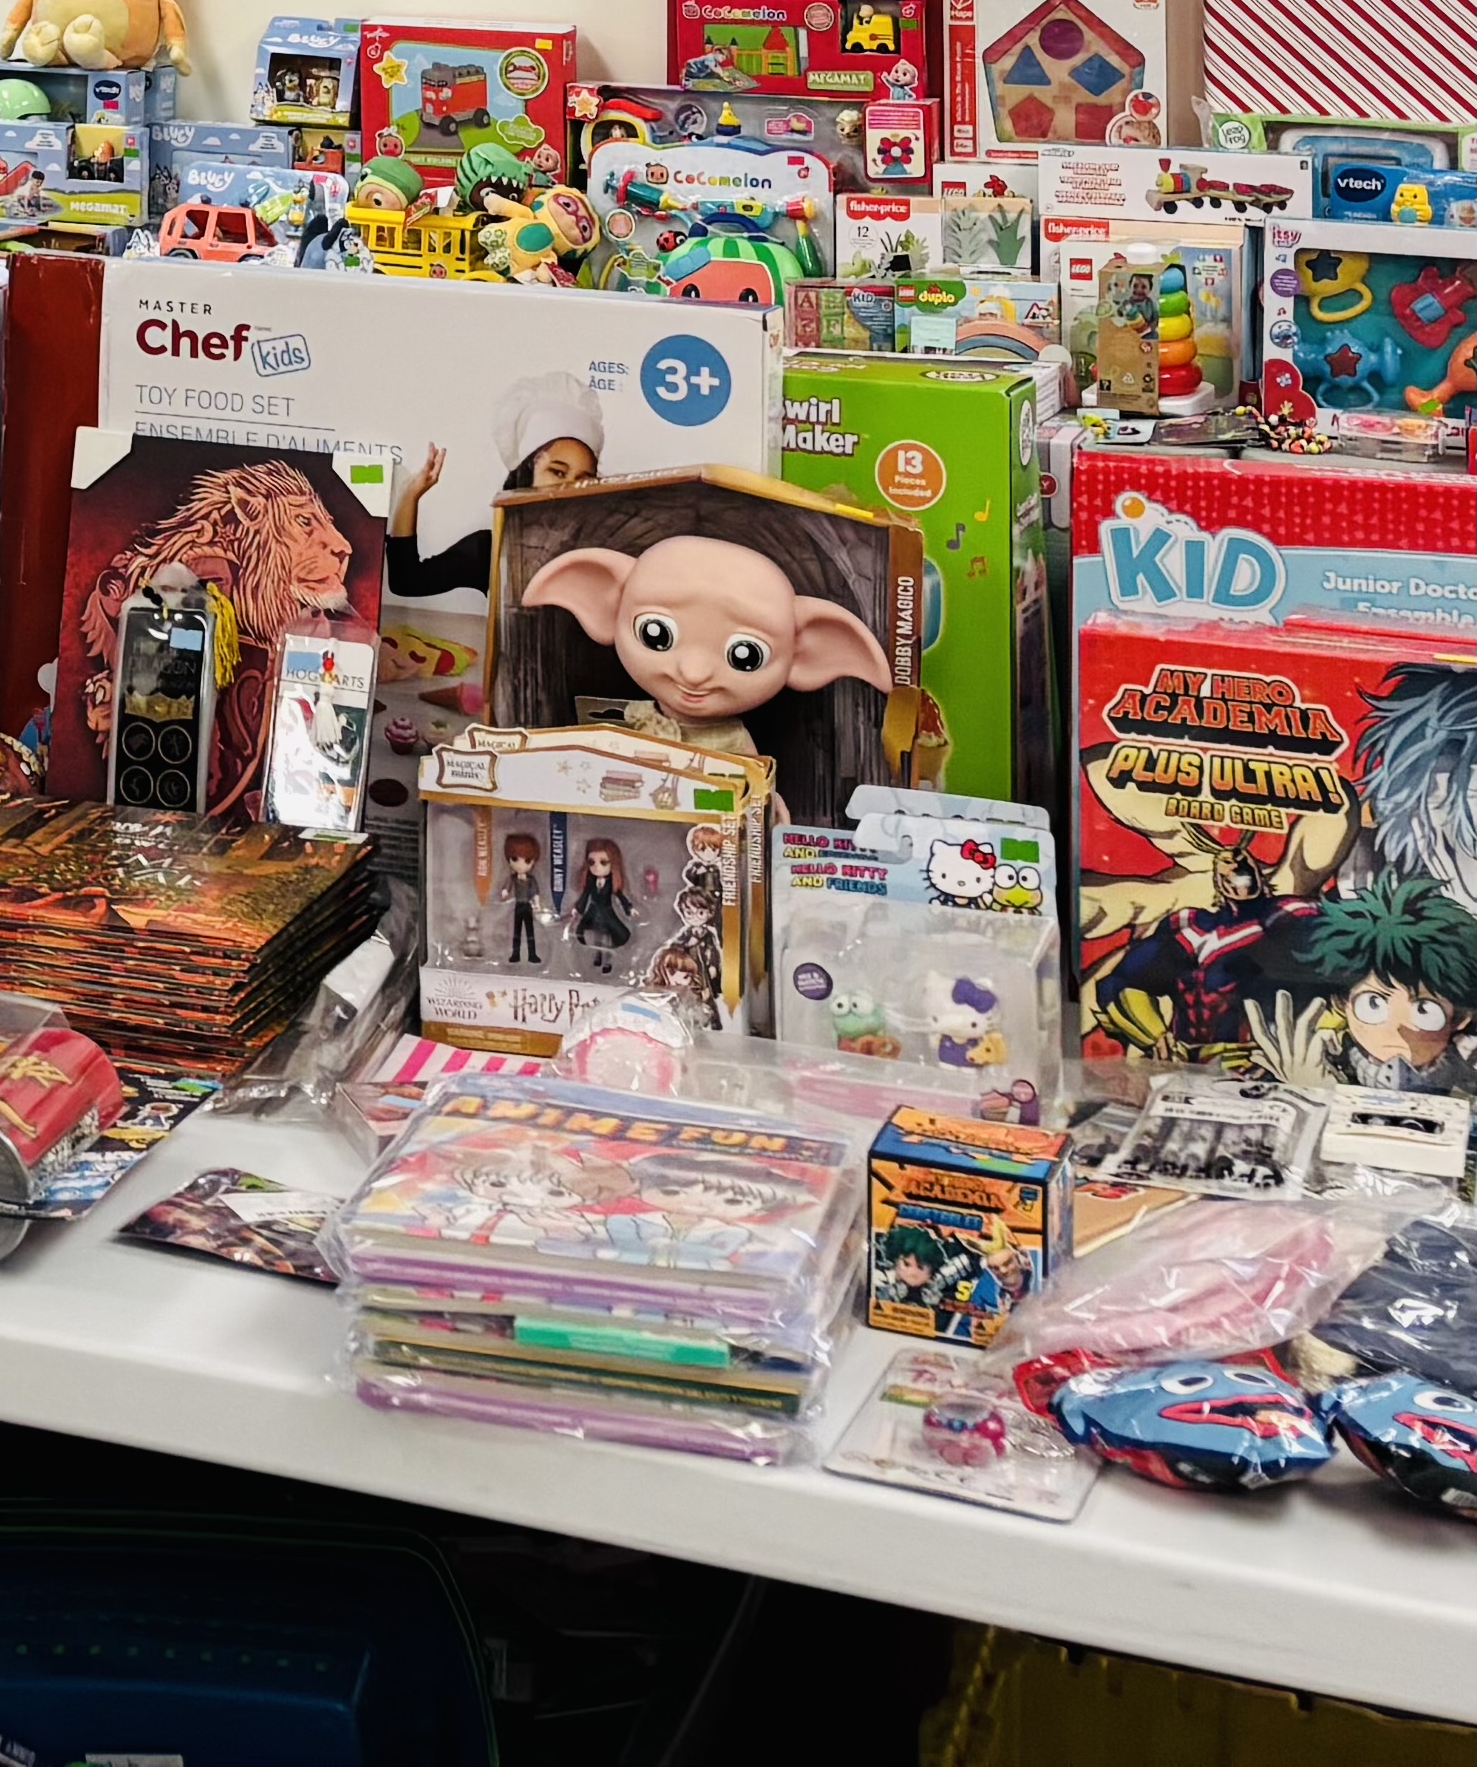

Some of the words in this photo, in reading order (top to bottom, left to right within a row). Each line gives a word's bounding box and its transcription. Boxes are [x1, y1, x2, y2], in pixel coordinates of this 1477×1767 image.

[808, 71, 868, 85] MEGAMAT
[1336, 177, 1382, 192] vtech
[849, 200, 908, 216] fisher-price
[857, 225, 870, 239] 12
[138, 298, 213, 316] MASTER
[918, 290, 955, 306] duplo
[136, 318, 252, 362] Chef
[257, 339, 306, 371] kids
[587, 359, 629, 376] AGES:
[654, 357, 721, 402] 3+
[135, 384, 178, 407] TOY
[184, 388, 244, 413] FOOD
[251, 394, 296, 418] SET
[897, 450, 924, 475] 13
[888, 486, 932, 499] Included
[894, 475, 928, 486] Pieces
[1109, 524, 1278, 608] KID
[1323, 571, 1403, 596] Junior
[1408, 576, 1477, 602] Docto
[895, 633, 913, 686] DOBBY
[1155, 668, 1206, 701] MY
[1212, 672, 1295, 707] HERO
[1110, 685, 1344, 742] ACADEMIA
[1108, 746, 1213, 791] PLUS
[1216, 756, 1344, 810] ULTRA!
[1164, 796, 1227, 825] BOARD
[1229, 801, 1285, 831] GAME
[553, 827, 565, 870] WEASLEY
[748, 817, 763, 884] FRIENDSHIP
[783, 846, 817, 859] AND
[722, 837, 737, 906] FRIENDSHIP
[791, 861, 838, 876] HELLO
[841, 864, 889, 882] KITTY
[791, 876, 824, 889] AND
[826, 876, 888, 897] FRIENDS
[434, 1007, 478, 1021] WORLD
[508, 987, 566, 1025] Harry
